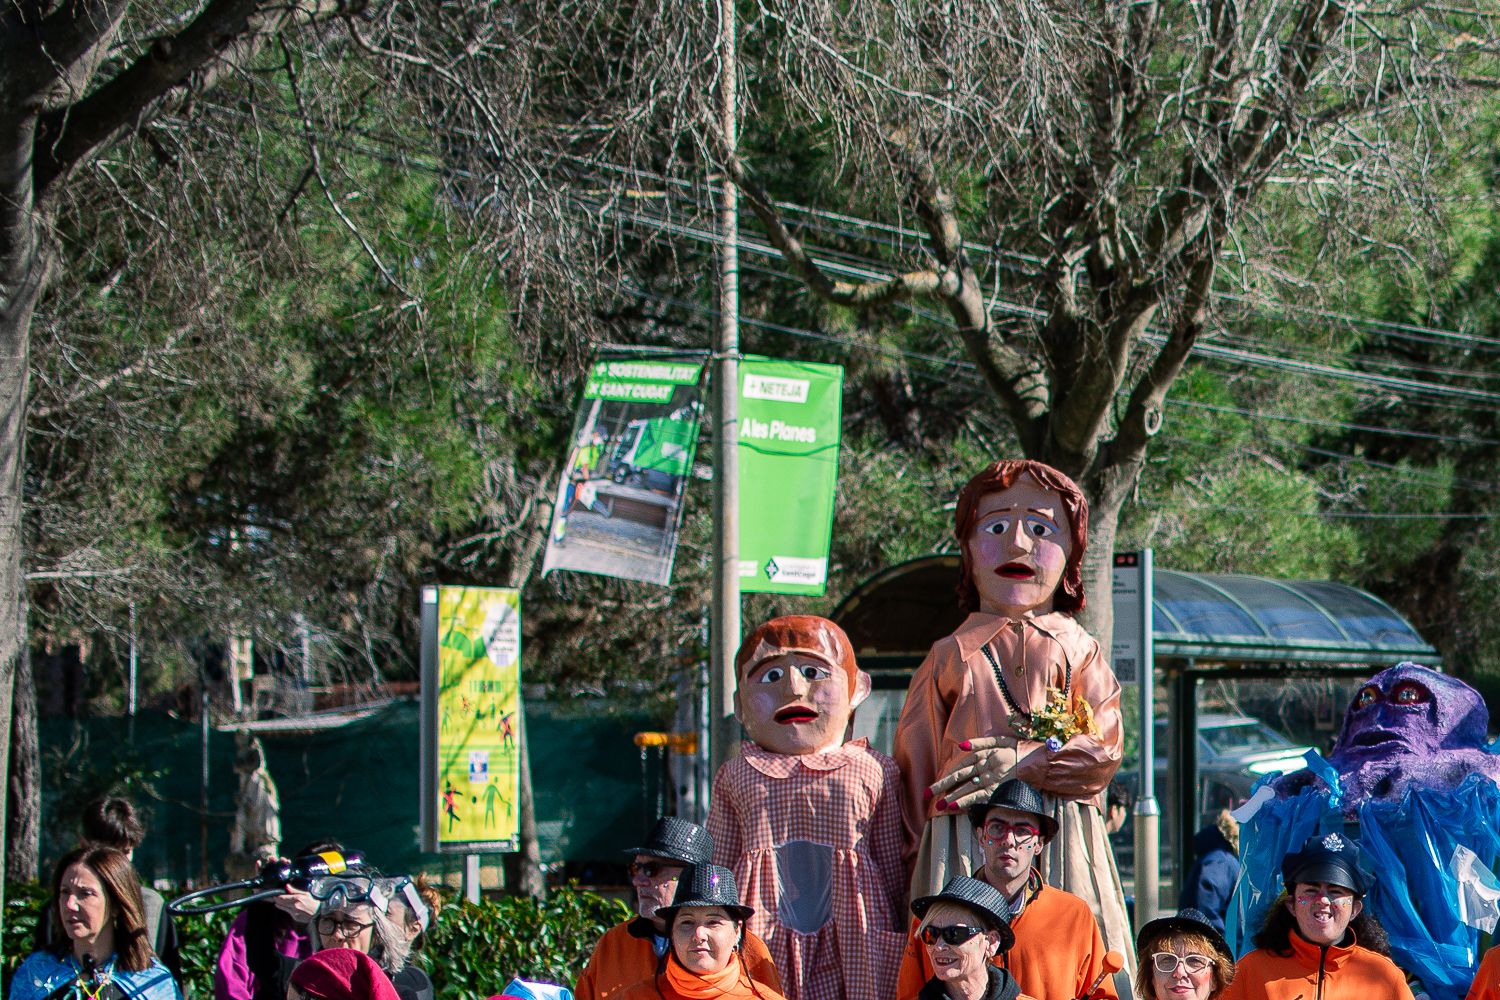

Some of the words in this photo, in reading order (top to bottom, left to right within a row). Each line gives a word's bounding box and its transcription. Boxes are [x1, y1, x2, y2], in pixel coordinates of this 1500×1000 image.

[760, 381, 803, 397] NETEJA
[740, 416, 751, 438] A
[751, 418, 768, 439] les
[769, 419, 817, 443] Planes
